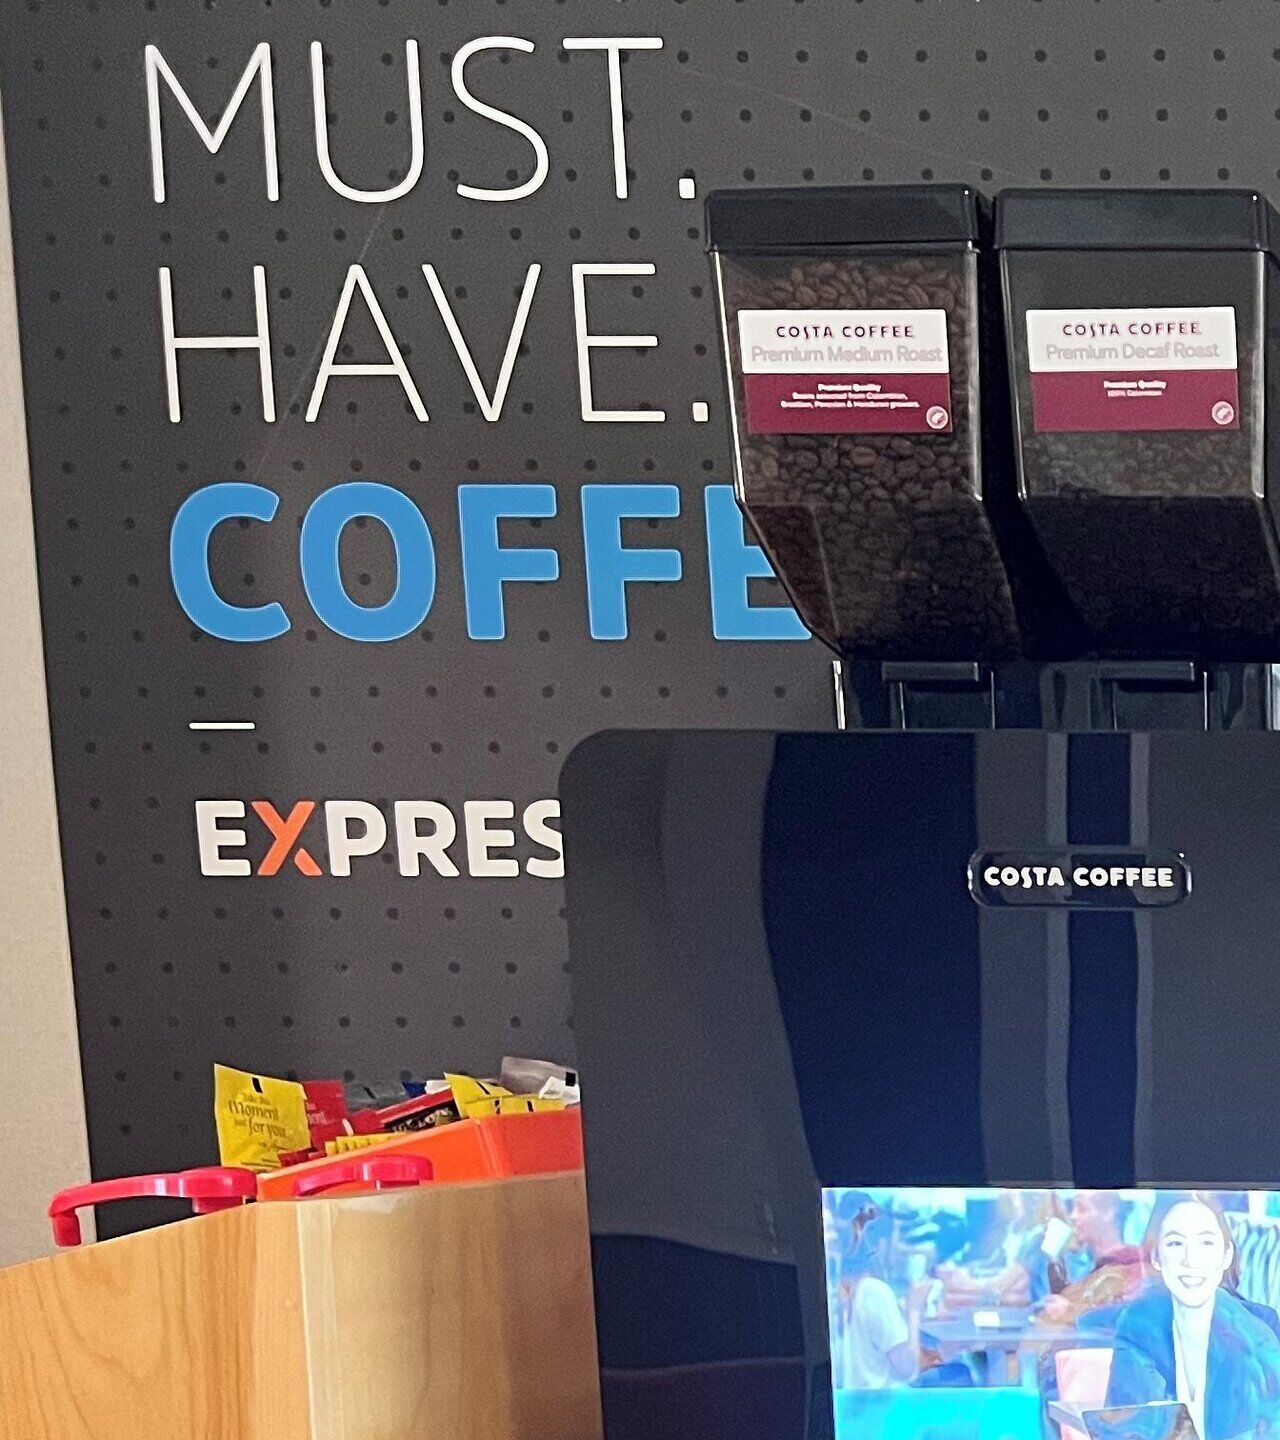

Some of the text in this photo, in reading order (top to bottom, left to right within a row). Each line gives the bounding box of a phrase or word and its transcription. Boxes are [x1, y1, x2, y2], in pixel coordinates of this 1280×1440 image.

[145, 36, 696, 203] MUST.
[776, 325, 915, 340] COSTA COFFEE
[1063, 322, 1201, 338] COSTA COFFEE
[159, 263, 708, 424] HAVE.
[1046, 342, 1220, 360] Premium Decaf Roast
[751, 345, 943, 362] Premium Medium Roast
[983, 866, 1175, 889] COSTA COFFEE
